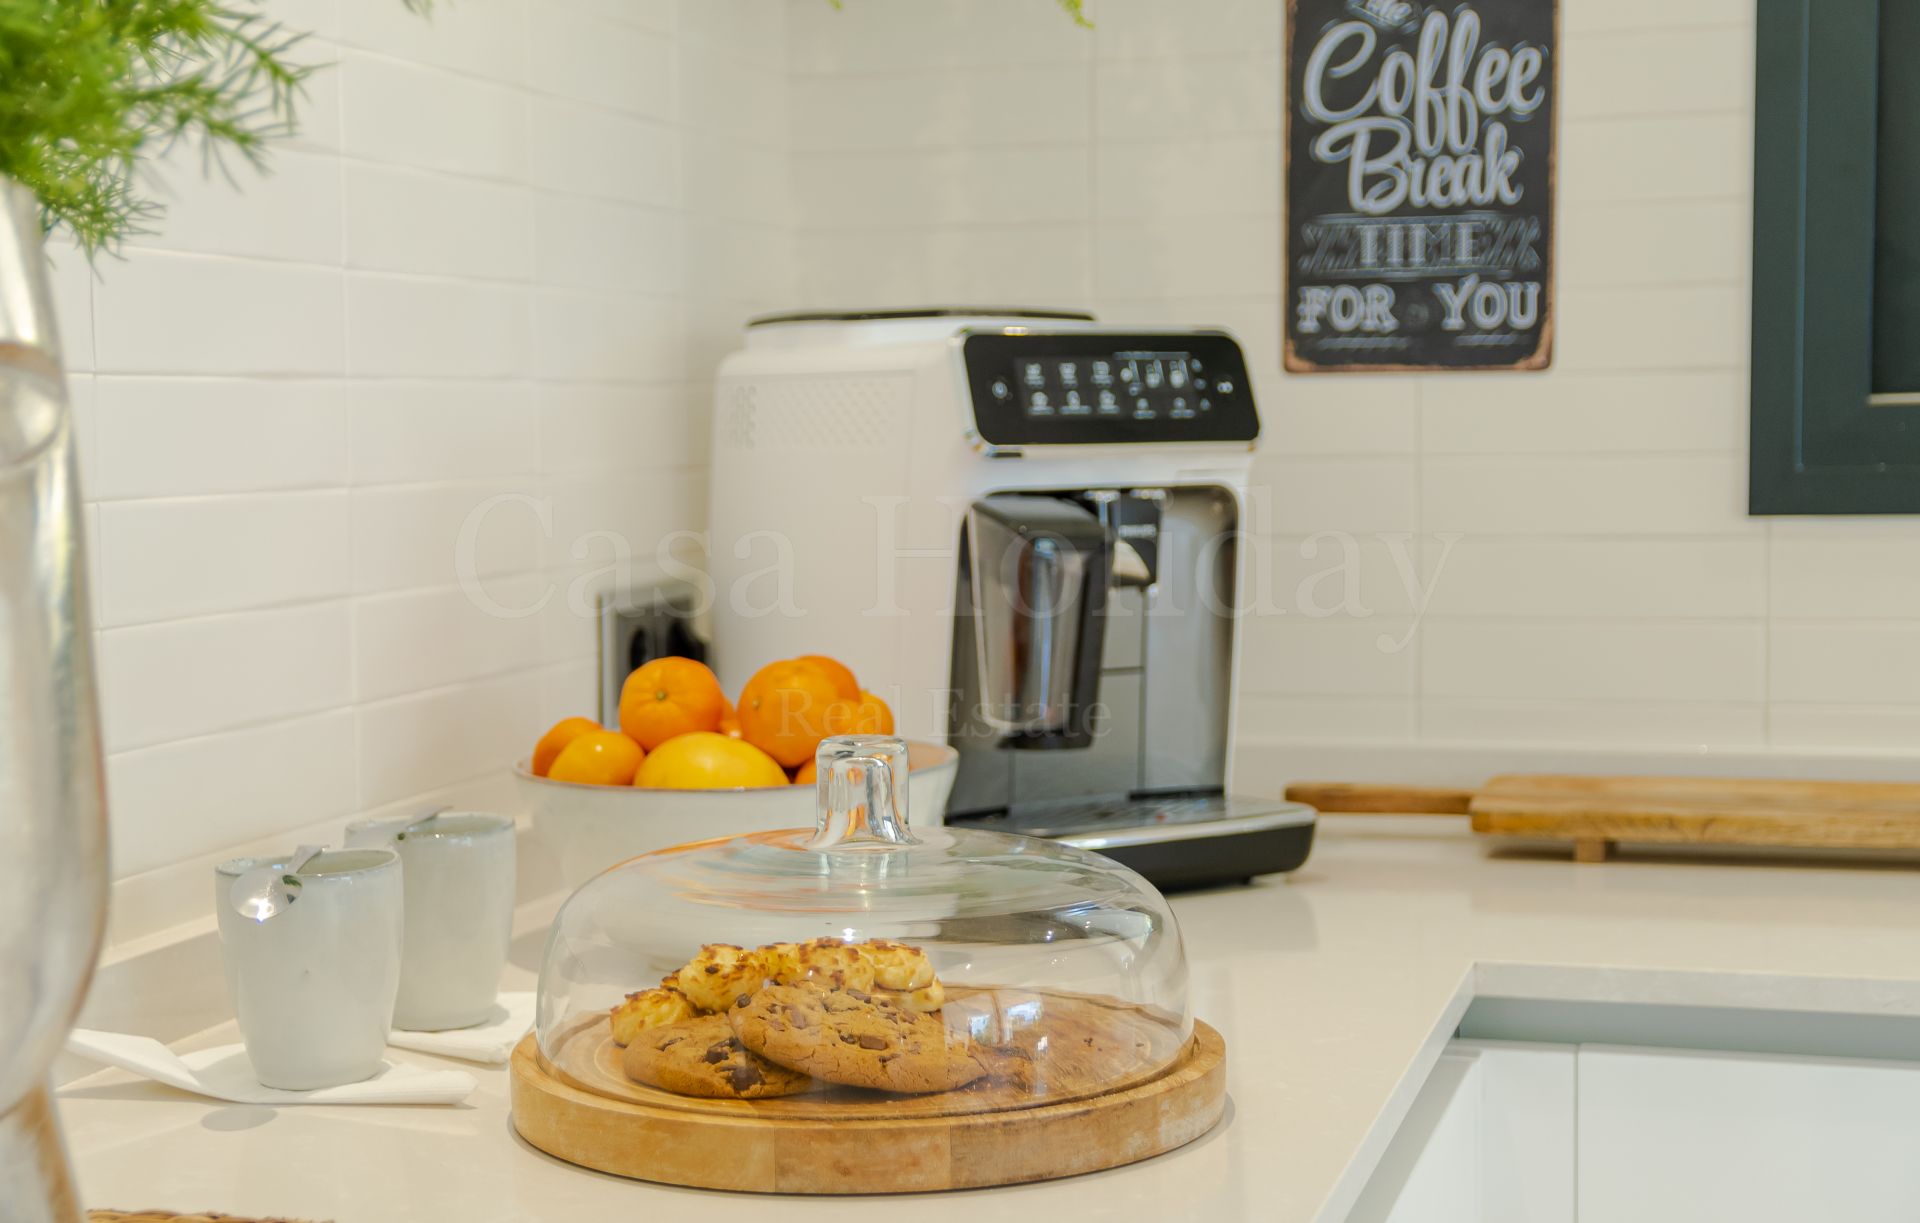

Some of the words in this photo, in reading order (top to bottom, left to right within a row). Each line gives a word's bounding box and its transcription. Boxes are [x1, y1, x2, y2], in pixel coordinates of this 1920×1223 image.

[1303, 9, 1546, 156] Coffee
[1314, 116, 1523, 215] Break
[1354, 222, 1487, 268] TIME
[1297, 284, 1398, 333] FOR
[1431, 273, 1541, 331] YOU
